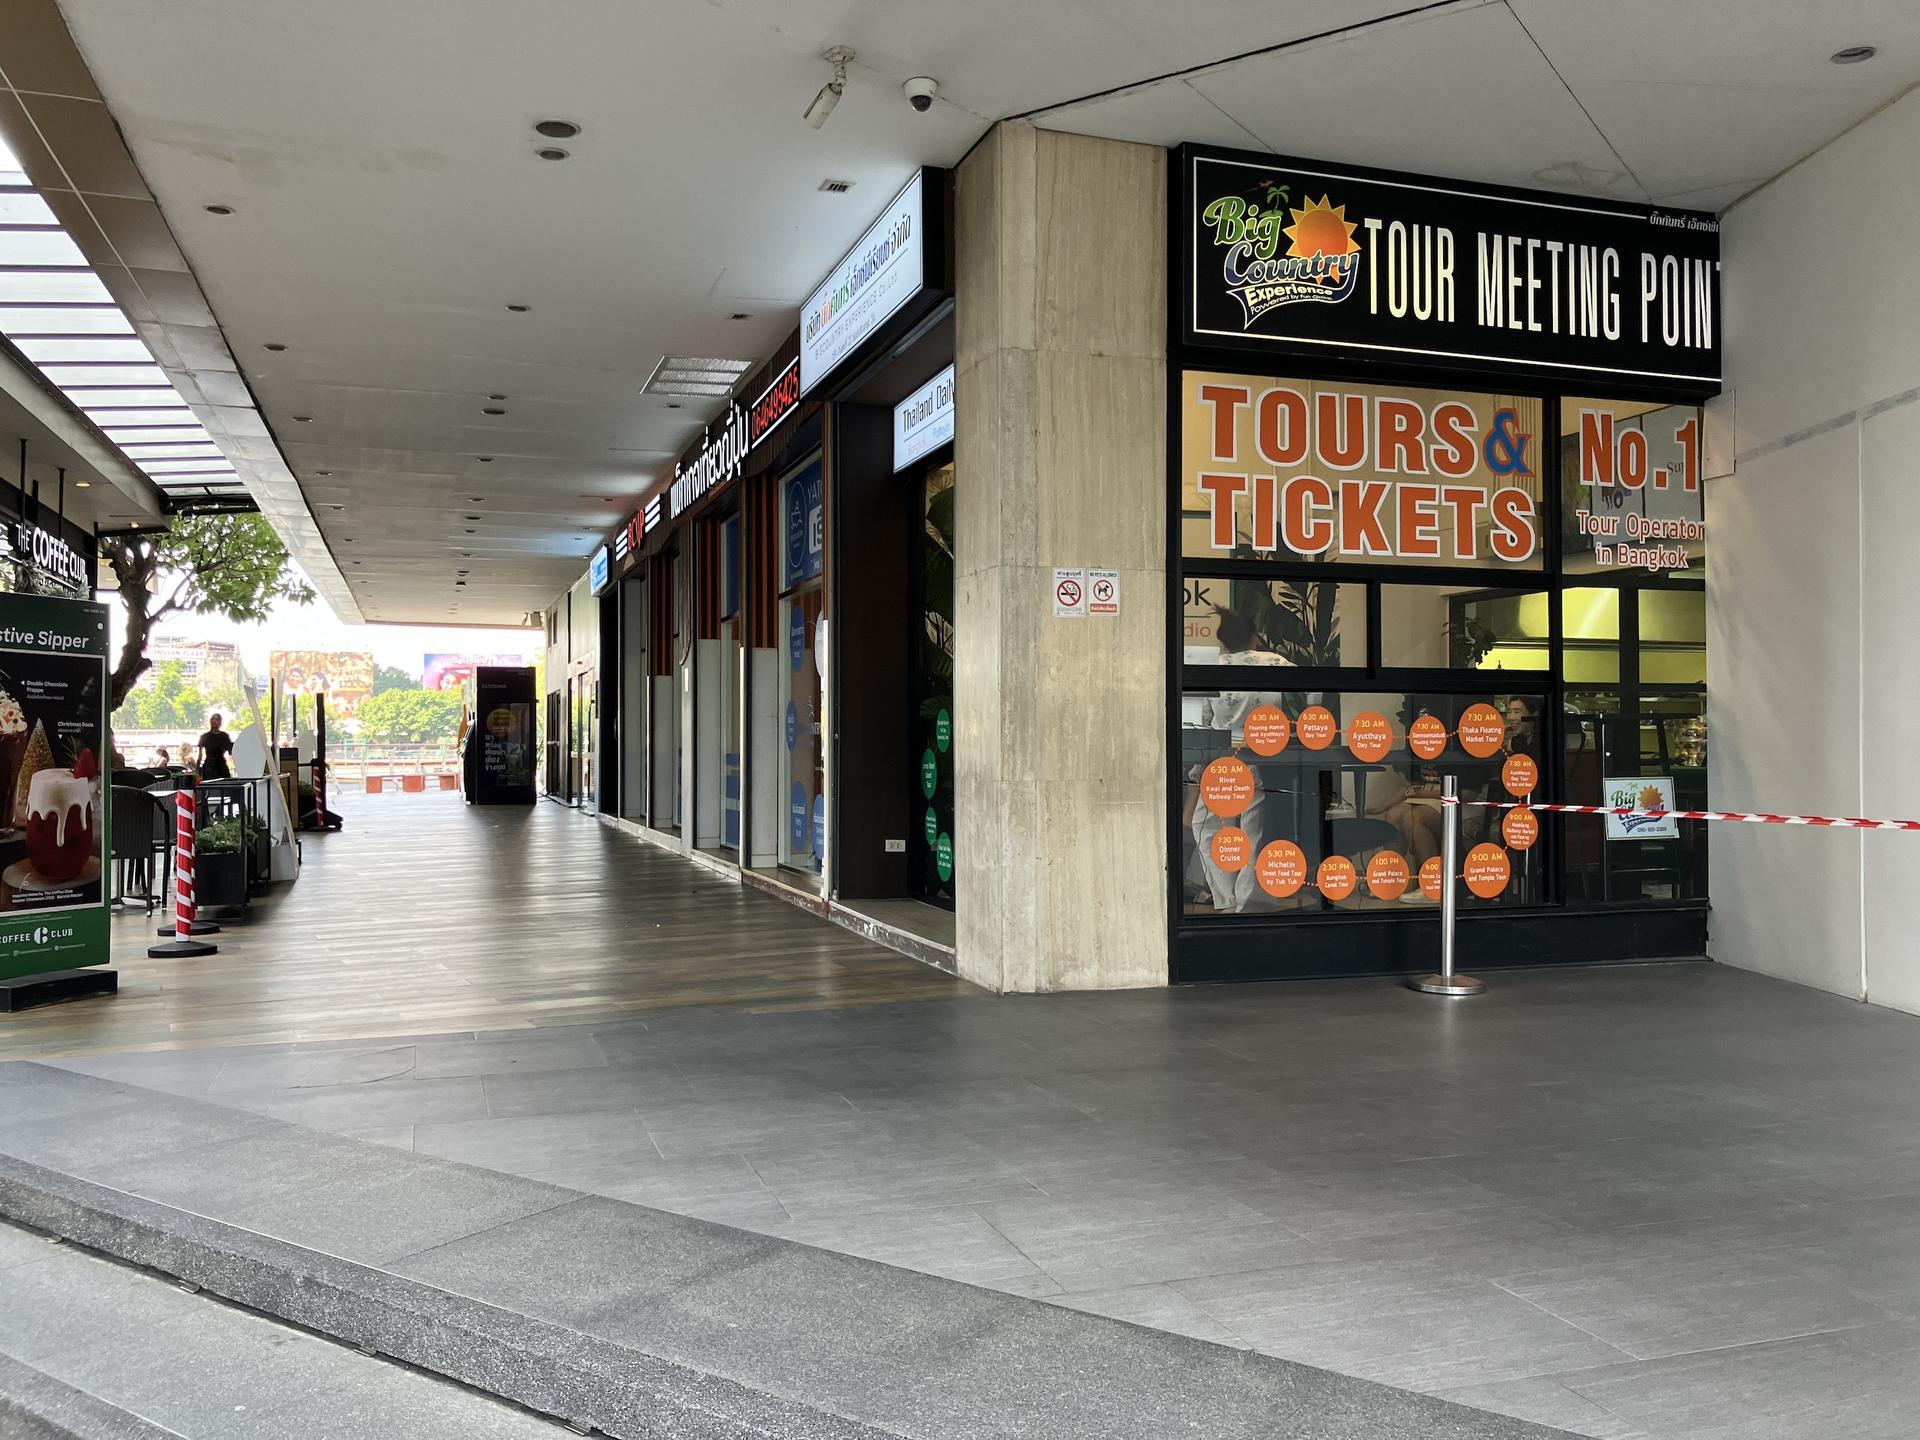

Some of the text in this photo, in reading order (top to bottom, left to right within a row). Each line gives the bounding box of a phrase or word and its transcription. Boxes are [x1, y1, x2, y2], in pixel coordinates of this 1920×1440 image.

[1203, 196, 1281, 259] Big
[1224, 241, 1359, 286] Country
[1244, 283, 1333, 308] Experience
[1364, 217, 1721, 349] TOUR MEETING POIN
[1250, 294, 1290, 315] Powered
[903, 391, 934, 432] Thailand
[1198, 383, 1537, 478] TOURS &
[1579, 407, 1699, 492] No.1
[1197, 470, 1536, 561] TICKETS
[1575, 509, 1705, 544] Tour Operator
[16, 523, 32, 553] THE
[33, 526, 69, 578] COFFEE
[1595, 542, 1689, 572] in Bangkok
[37, 630, 89, 651] Sipper
[1352, 732, 1386, 741] Ayutthaya
[1355, 720, 1369, 728] 7:30
[1462, 726, 1501, 734] Thaka Floating
[1465, 735, 1484, 743] Market
[1611, 790, 1636, 809] Big
[1472, 853, 1502, 862] 9:00 AM
[0, 928, 73, 944] OFFEE CLUB
